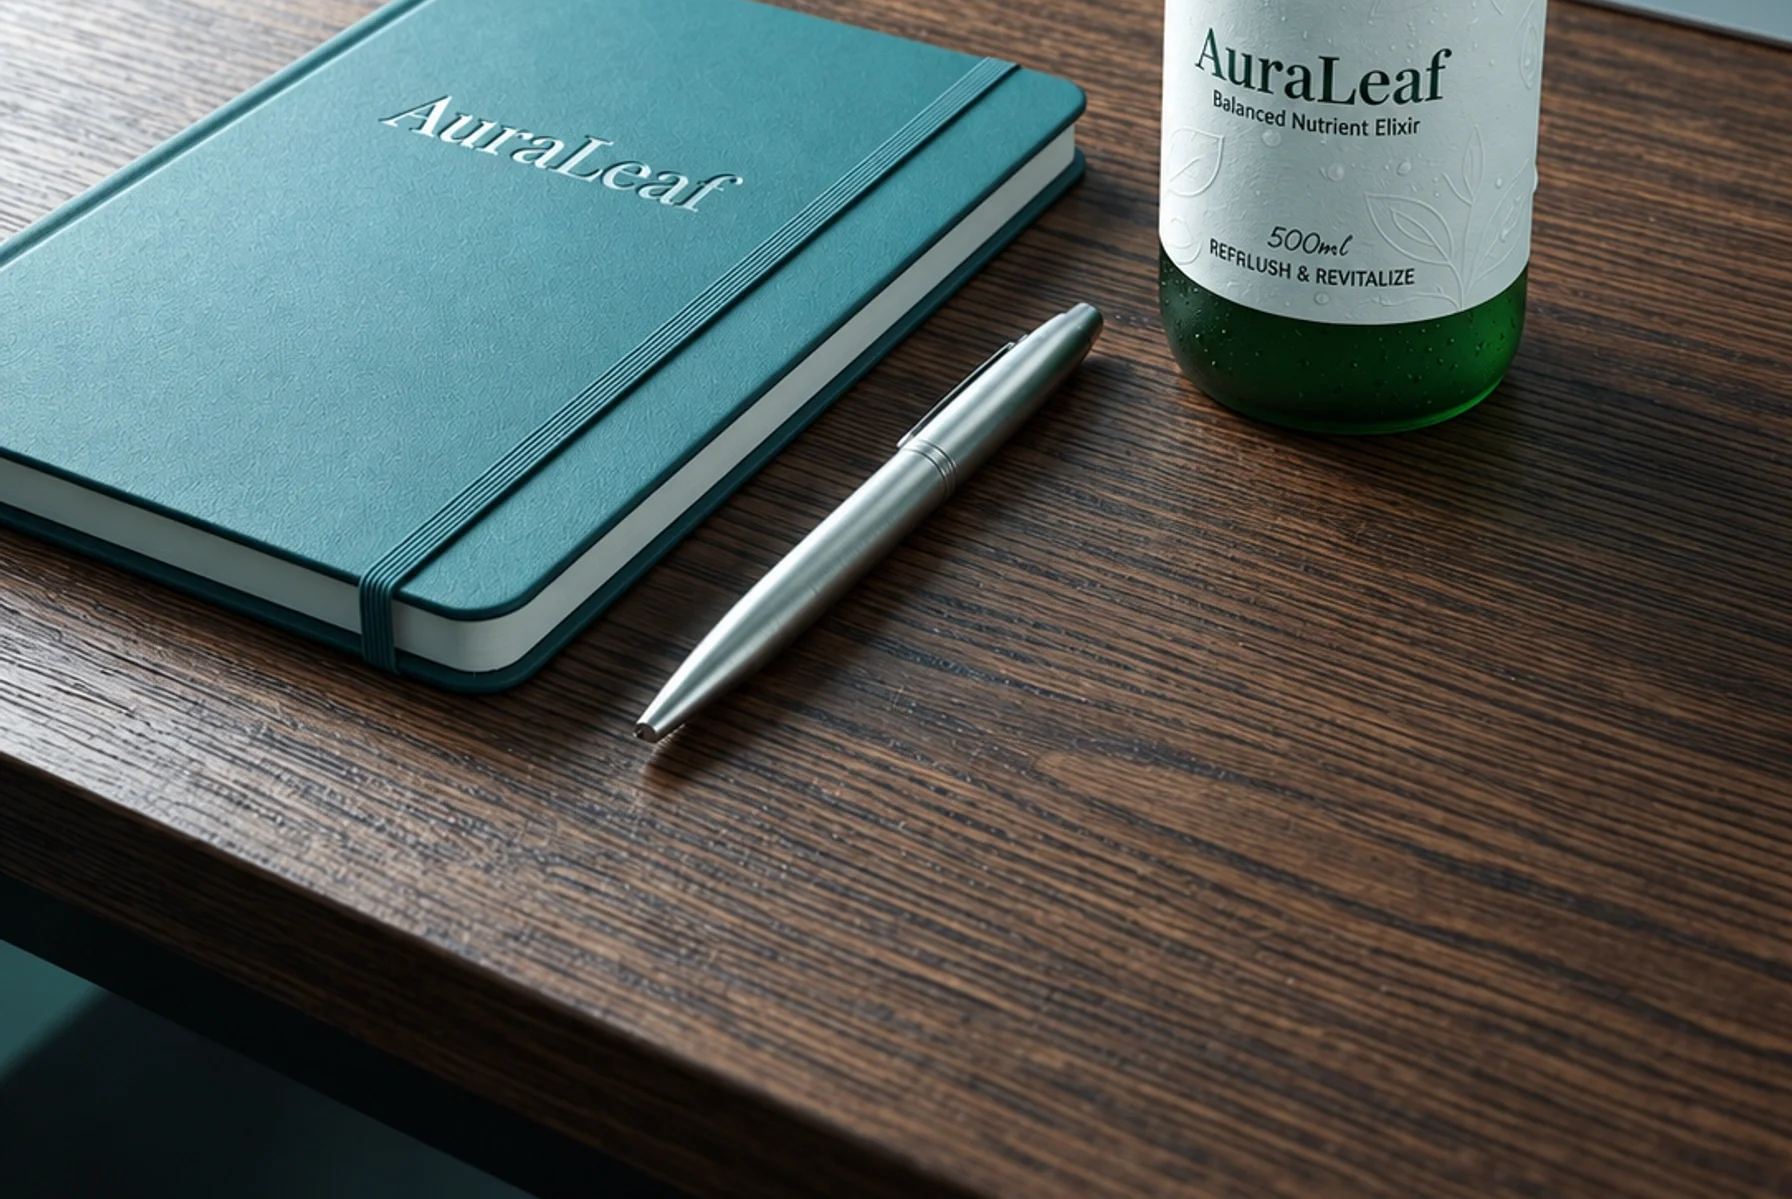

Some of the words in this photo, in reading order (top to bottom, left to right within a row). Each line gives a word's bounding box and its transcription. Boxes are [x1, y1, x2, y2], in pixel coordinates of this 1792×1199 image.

[1195, 27, 1452, 106] AuraLeaf
[1212, 89, 1286, 128] Balanced
[1291, 112, 1369, 137] Nutrient
[1375, 116, 1422, 137] Elixir
[377, 94, 744, 212] AuraLeaf
[1267, 226, 1354, 257] 500ml
[1297, 264, 1310, 283] &
[1315, 267, 1416, 288] REVITALIZE
